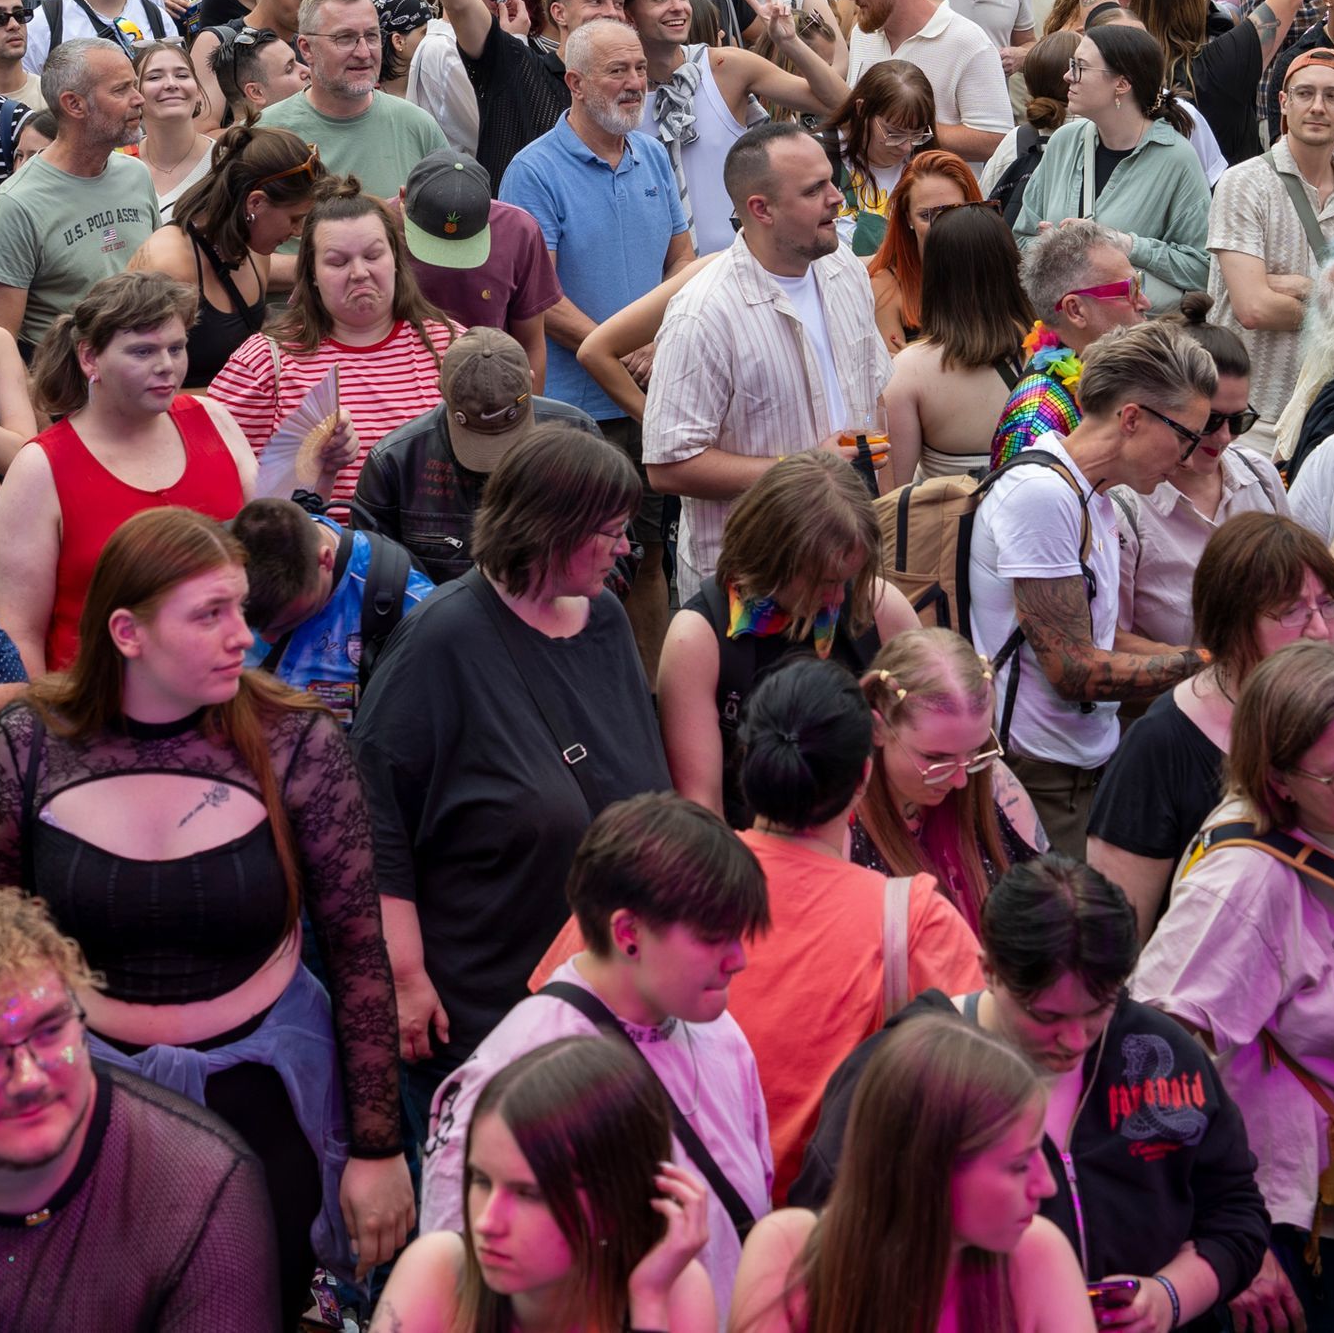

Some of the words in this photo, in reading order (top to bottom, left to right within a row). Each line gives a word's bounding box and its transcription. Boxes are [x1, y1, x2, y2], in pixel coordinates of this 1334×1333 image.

[63, 225, 87, 246] U.S.
[87, 211, 115, 230] POLO
[1108, 1067, 1207, 1130] paranoid
